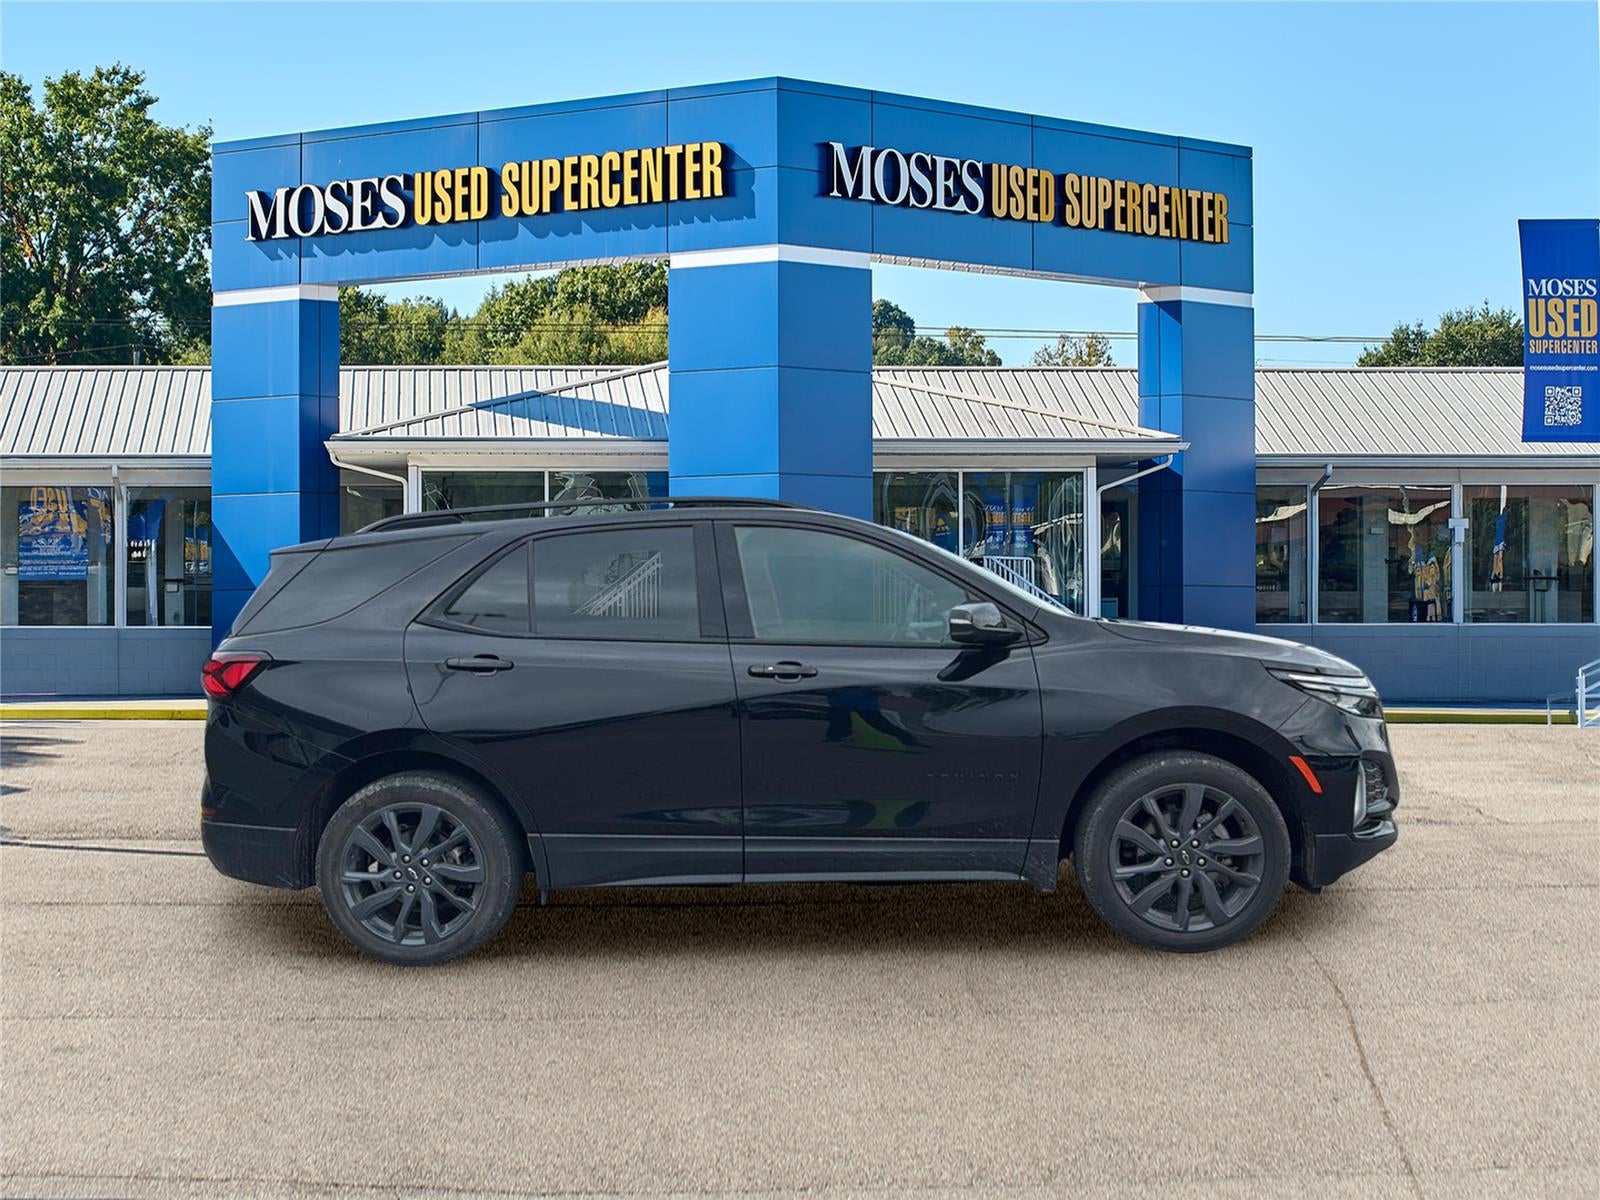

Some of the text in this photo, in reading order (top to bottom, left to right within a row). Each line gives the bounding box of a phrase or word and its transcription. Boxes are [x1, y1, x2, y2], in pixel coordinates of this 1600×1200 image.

[244, 141, 723, 242] MOSES USED SUPERCENTER
[828, 141, 1229, 244] MOSES USED SUPERCENTER
[1527, 278, 1597, 297] MOSES
[1528, 298, 1598, 338] USED
[1529, 339, 1598, 354] SUPERCENTER
